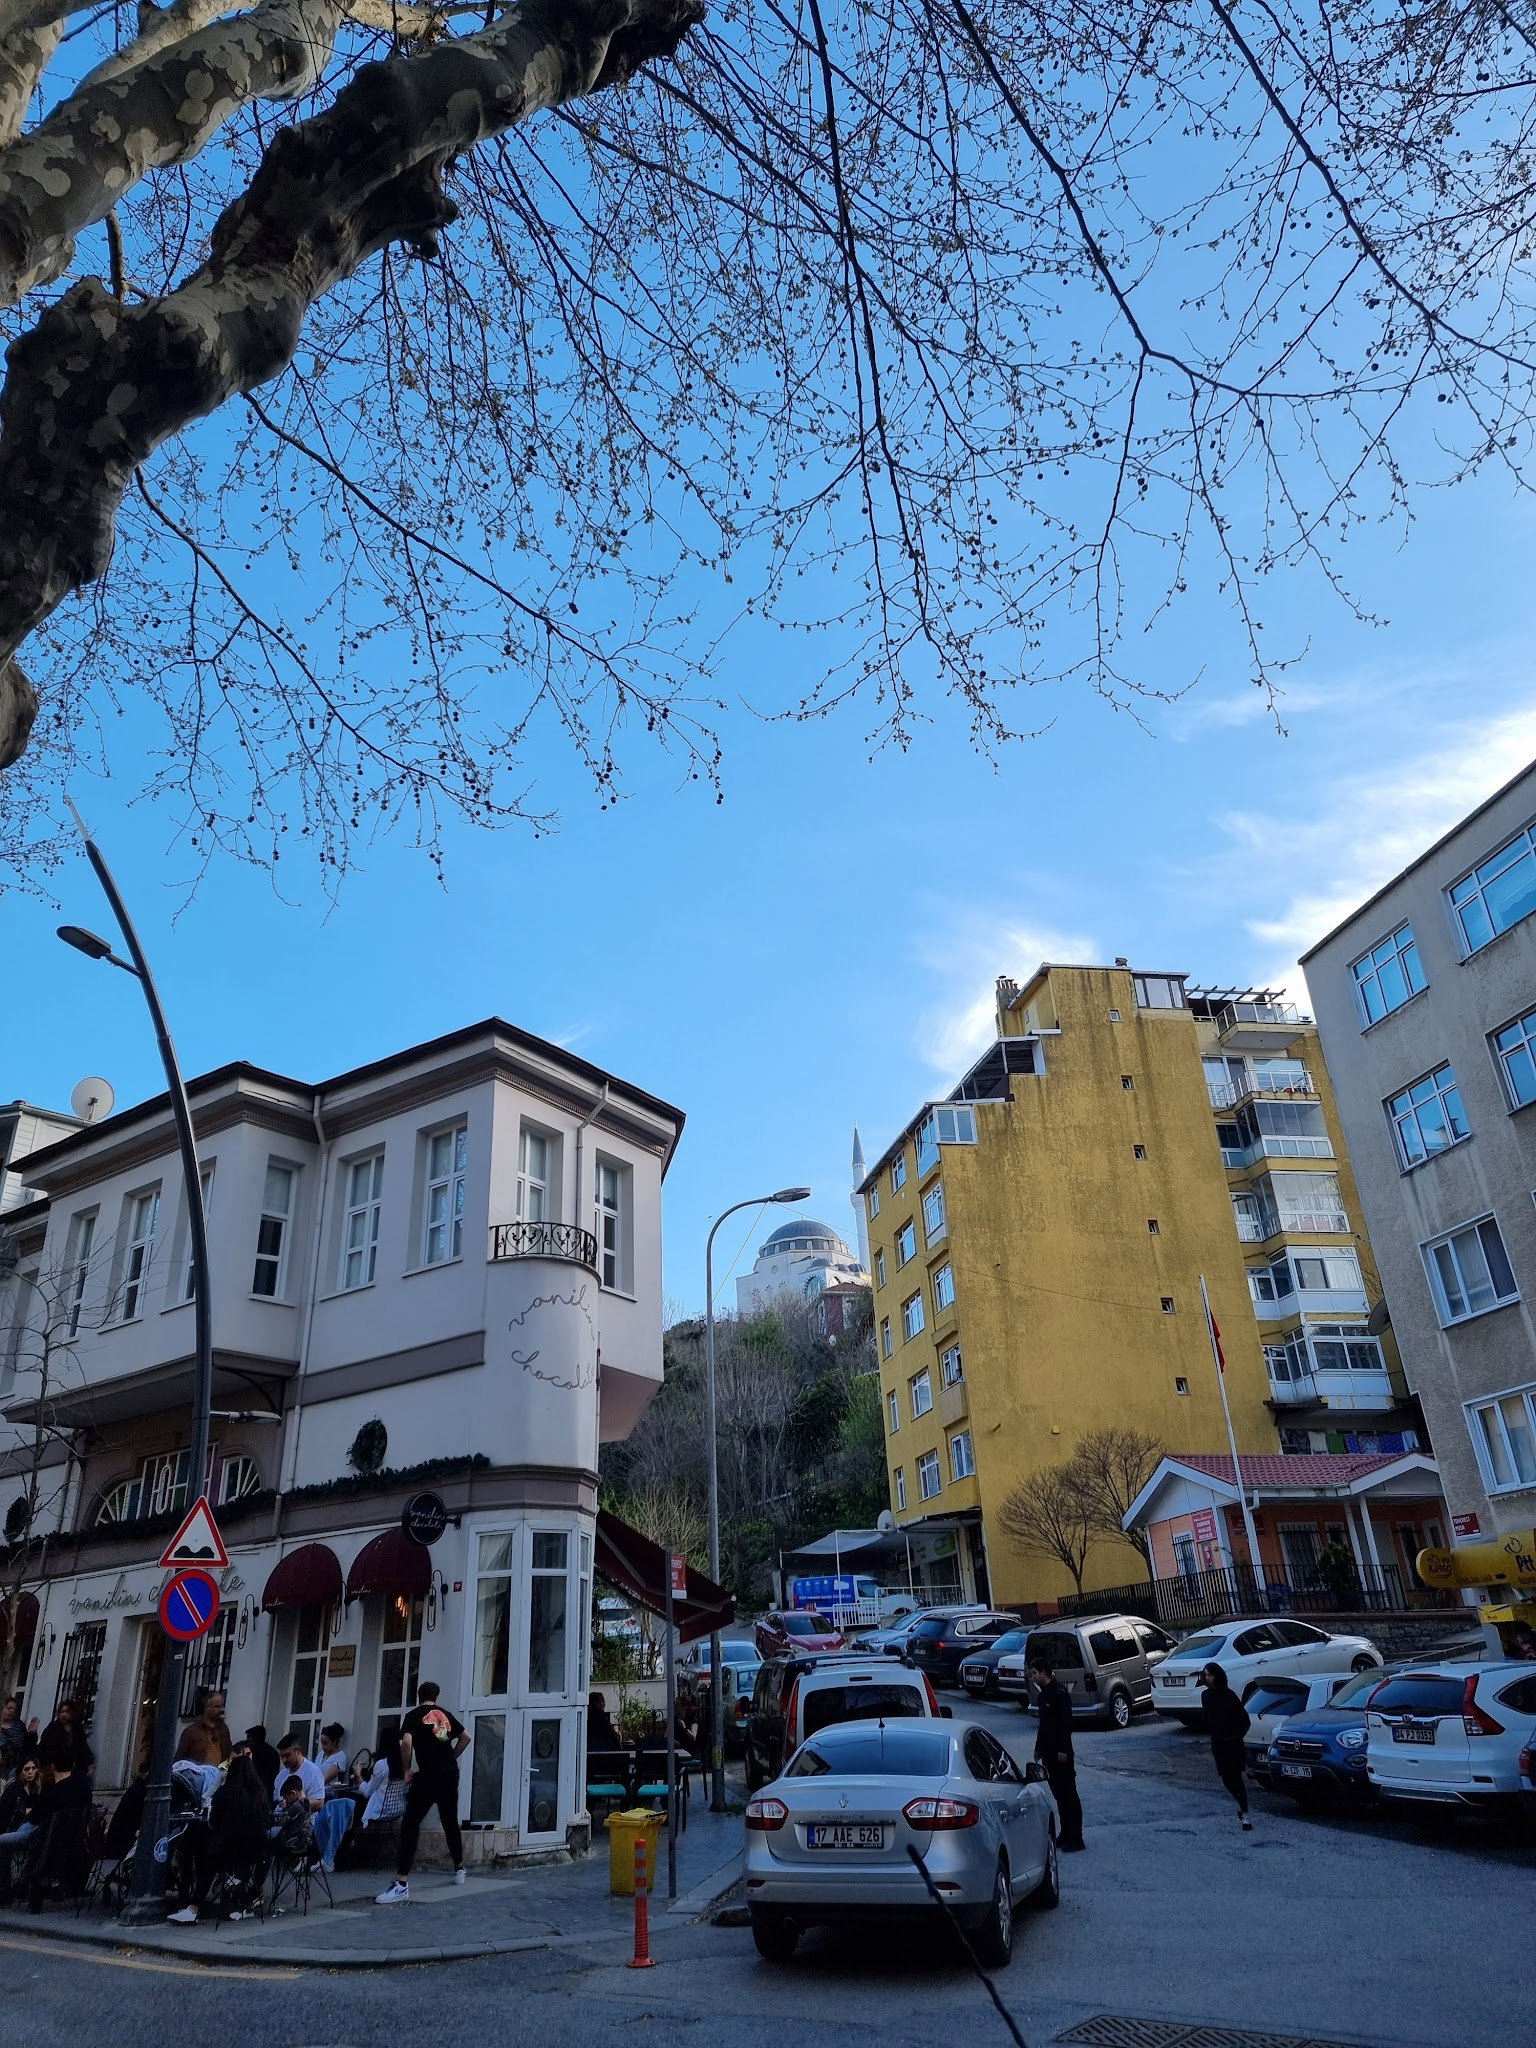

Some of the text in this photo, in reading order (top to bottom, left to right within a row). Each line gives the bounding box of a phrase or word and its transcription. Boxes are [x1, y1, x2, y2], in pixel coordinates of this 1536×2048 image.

[816, 1827, 880, 1842] 17 AAE 626
